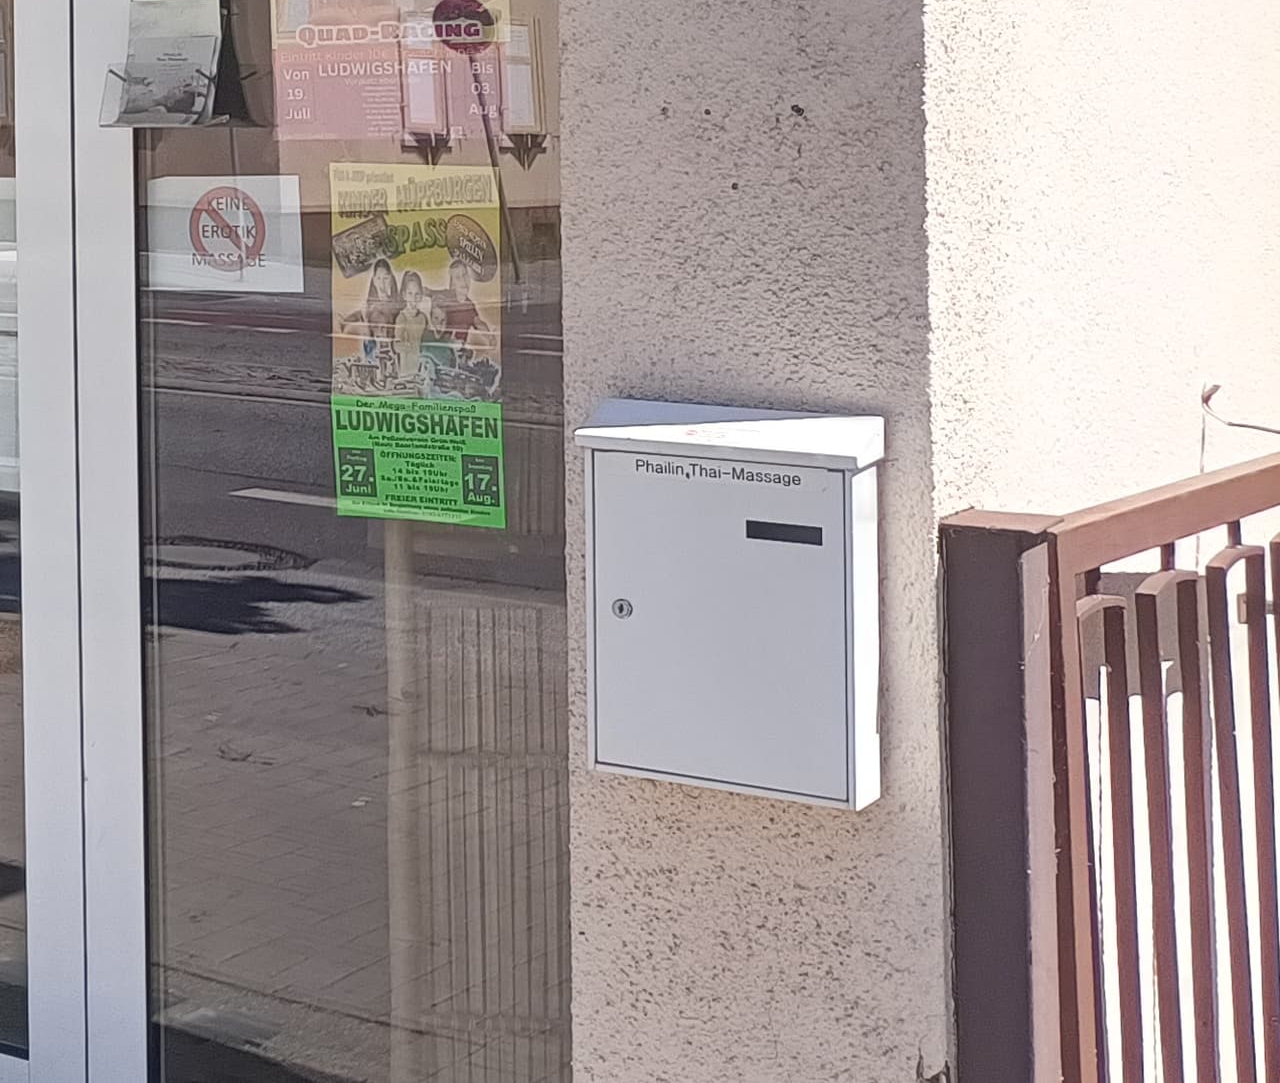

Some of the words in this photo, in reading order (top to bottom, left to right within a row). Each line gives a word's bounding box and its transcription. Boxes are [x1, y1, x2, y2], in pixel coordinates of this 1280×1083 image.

[318, 60, 452, 78] LUDWIGSHAFEN
[471, 61, 494, 74] Bis
[283, 69, 310, 82] Von
[286, 107, 311, 120] Juli
[208, 197, 252, 211] KEINE
[202, 224, 257, 239] EROTIK
[384, 218, 449, 252] SPASS
[192, 253, 267, 268] MASSAGE
[356, 399, 375, 409] Der
[335, 410, 499, 439] LUDWIGSHAFEN
[341, 464, 374, 482] 27.
[689, 463, 801, 487] Thai-Massage
[345, 483, 372, 494] Juni
[464, 473, 497, 491] 17.
[385, 494, 417, 504] FREIER
[419, 495, 458, 506] EINTRITT
[467, 492, 495, 505] Aug.
